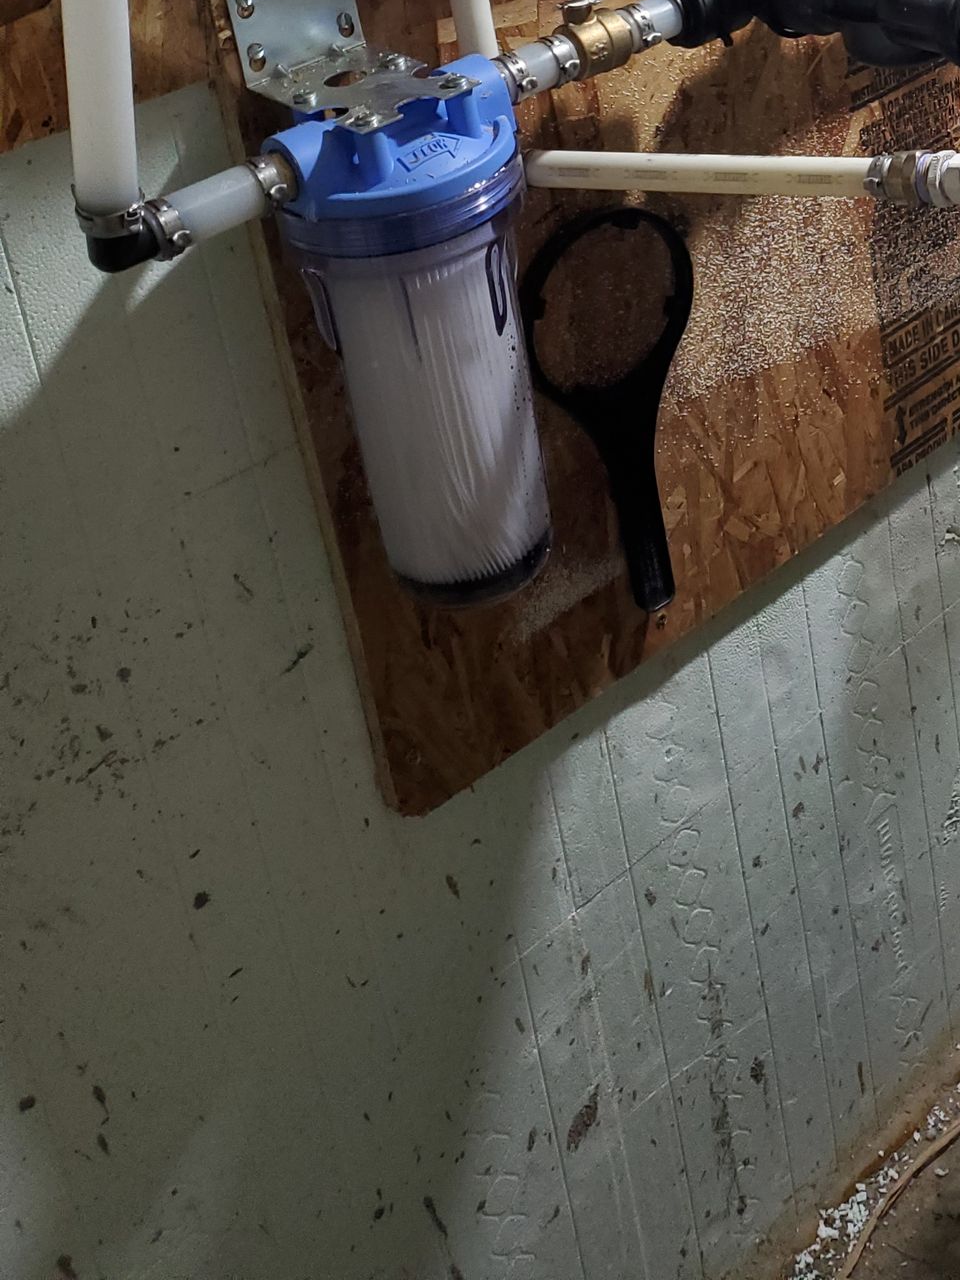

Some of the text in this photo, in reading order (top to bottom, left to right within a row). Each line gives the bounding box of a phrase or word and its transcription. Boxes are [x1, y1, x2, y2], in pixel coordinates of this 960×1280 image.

[887, 325, 919, 358] MADE
[921, 315, 935, 337] IN
[920, 336, 950, 370] SIDE
